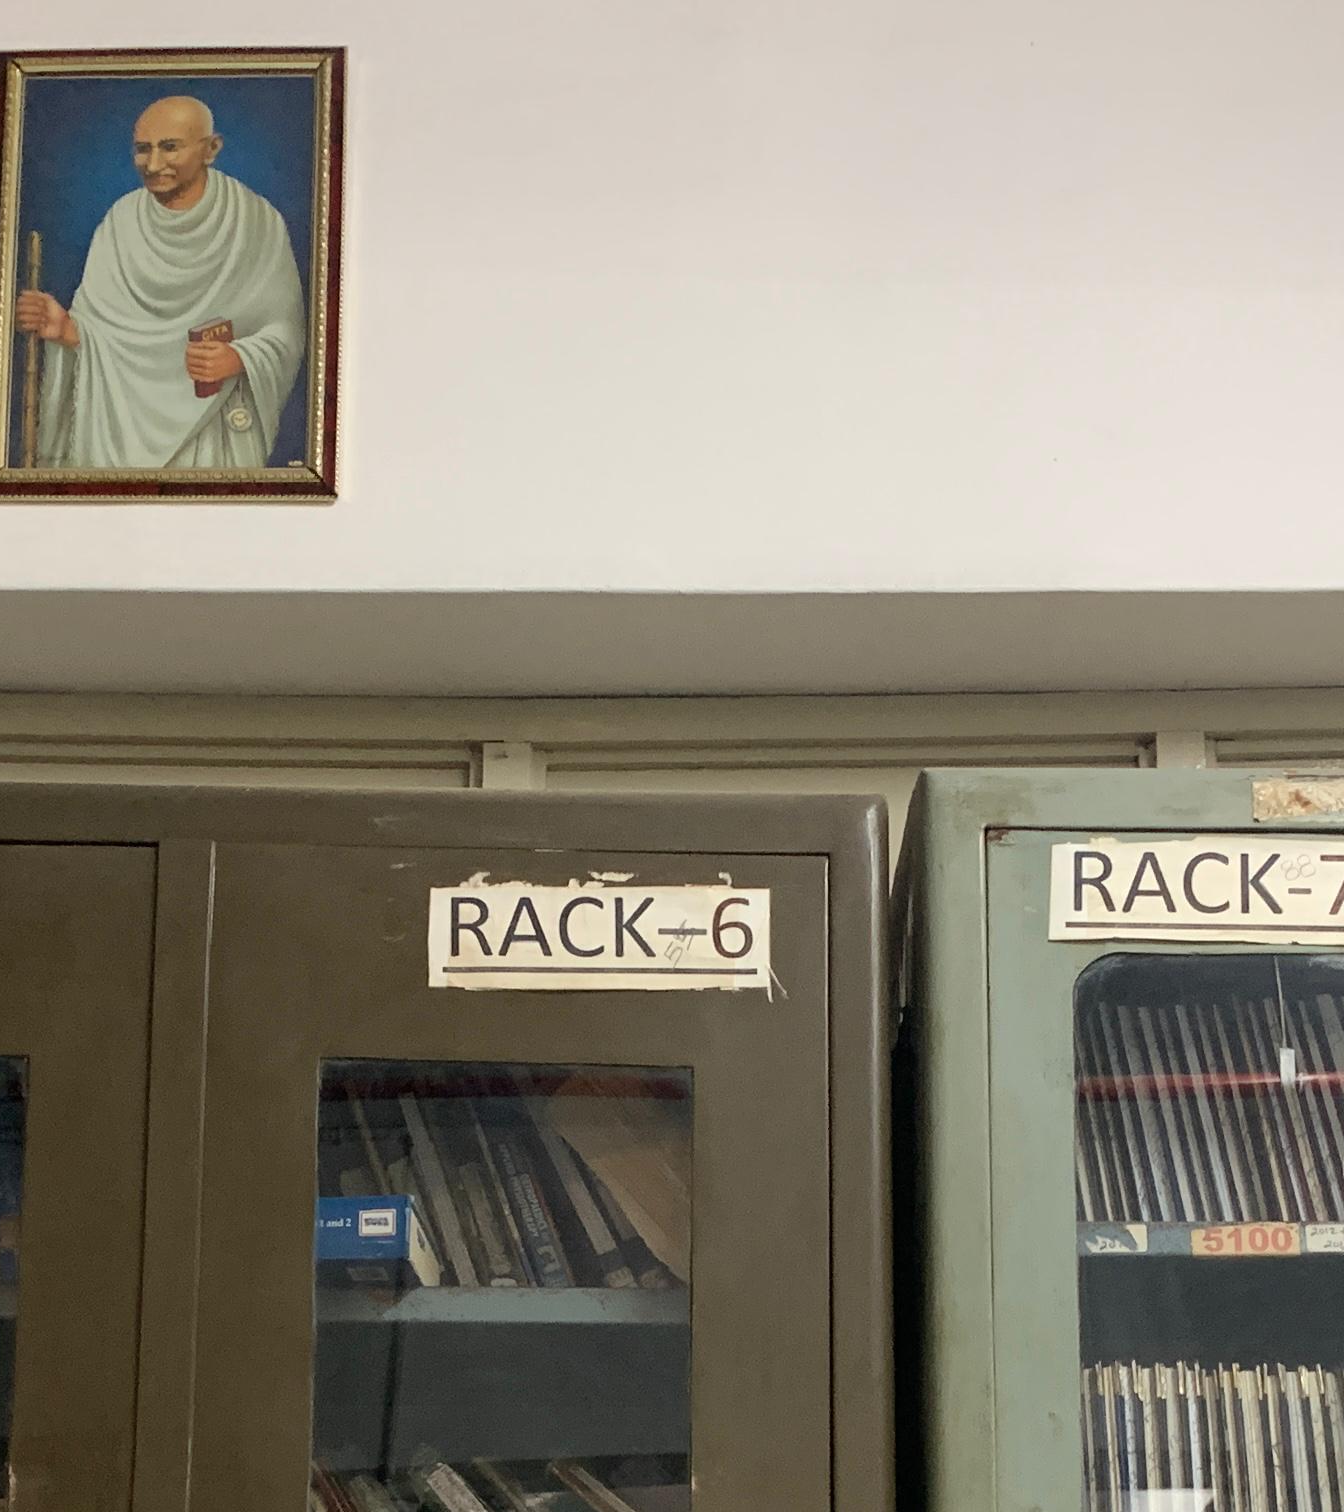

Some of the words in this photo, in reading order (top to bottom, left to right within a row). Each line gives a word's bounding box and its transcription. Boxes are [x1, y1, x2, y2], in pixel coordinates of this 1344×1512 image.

[201, 324, 229, 341] GITA
[449, 896, 755, 959] RACK-6
[326, 1218, 344, 1227] and
[345, 1218, 352, 1227] 2
[1202, 1227, 1292, 1252] 5100
